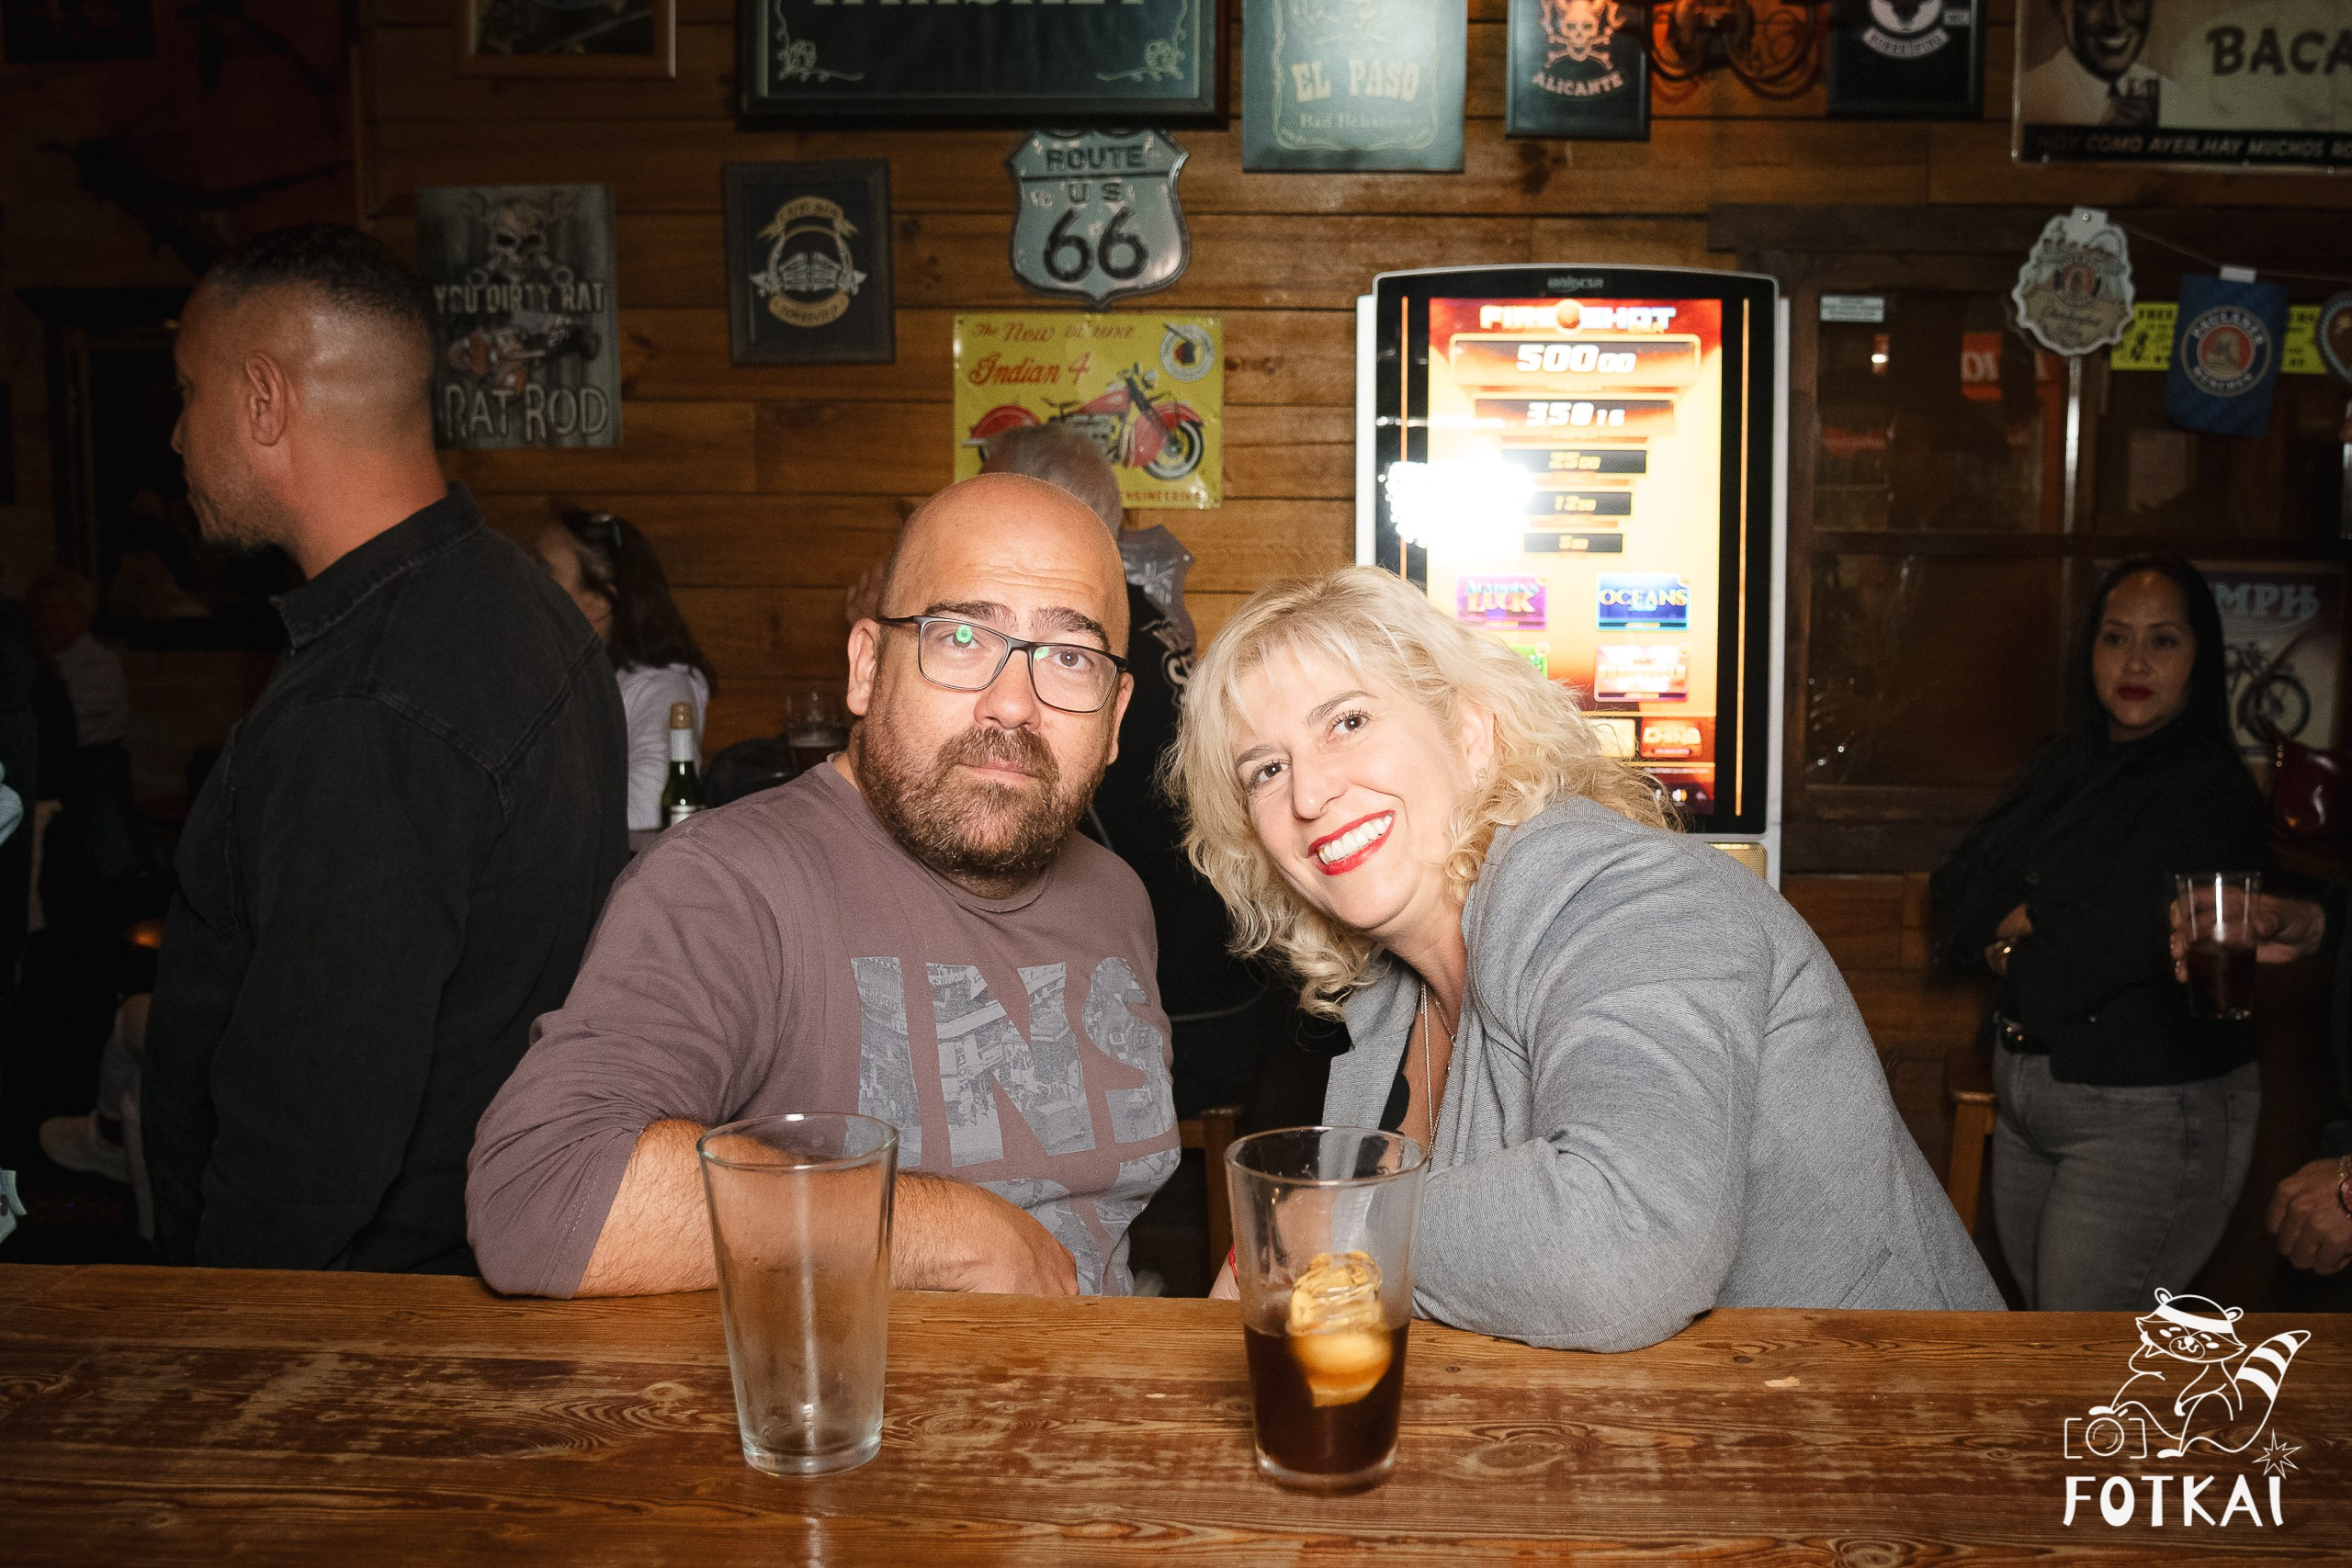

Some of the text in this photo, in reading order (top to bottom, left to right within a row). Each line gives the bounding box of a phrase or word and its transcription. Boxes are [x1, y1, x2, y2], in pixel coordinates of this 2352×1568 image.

[2206, 26, 2352, 76] BACA
[1291, 59, 1420, 103] EL PASO
[1532, 72, 1623, 96] ALICANTE
[1046, 144, 1145, 172] ROUTE
[2086, 135, 2143, 152] COMO
[2246, 139, 2324, 157] MUCHOS
[1045, 209, 1148, 283] 66
[434, 283, 605, 313] YOU DIRTY RAT
[974, 322, 998, 336] The
[1003, 322, 1056, 343] New
[969, 351, 1091, 385] Indian 4
[445, 382, 609, 441] RAT ROD
[1466, 592, 1535, 614] LUCK
[1598, 588, 1689, 606] OCEANS
[2209, 581, 2315, 618] MPH
